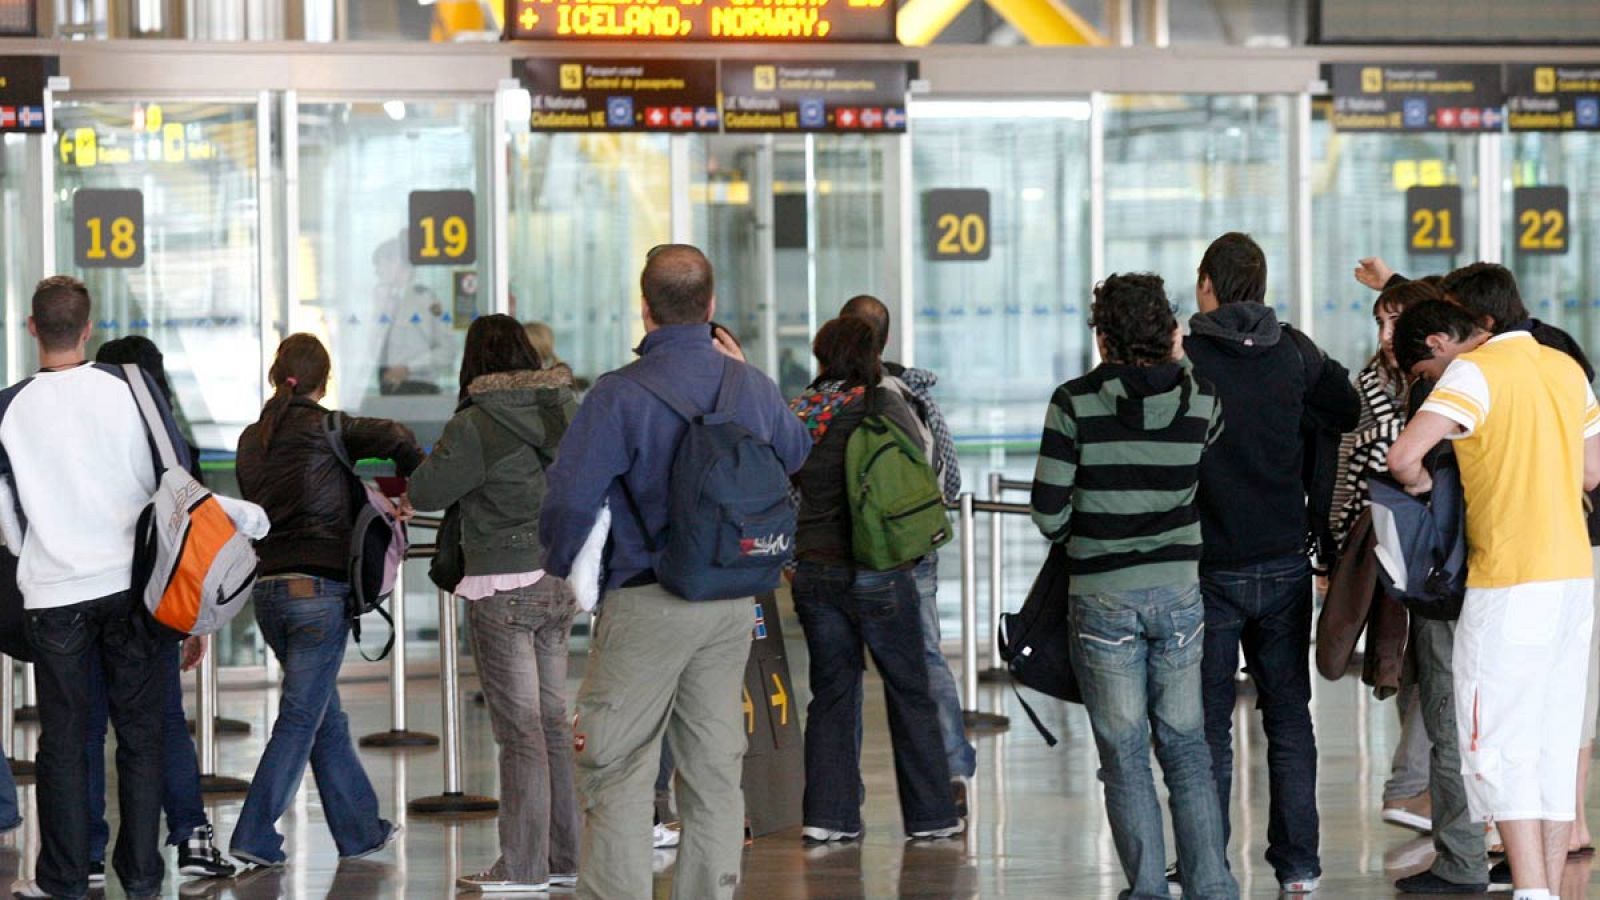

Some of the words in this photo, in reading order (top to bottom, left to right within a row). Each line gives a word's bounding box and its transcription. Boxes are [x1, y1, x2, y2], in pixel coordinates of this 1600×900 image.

[556, 5, 692, 36] ICELAND,
[711, 6, 831, 37] NORWAY,
[586, 76, 619, 89] Control
[621, 77, 633, 89] de
[86, 216, 136, 260] 18
[420, 215, 468, 257] 19
[937, 213, 985, 254] 20
[1412, 208, 1455, 249] 21
[1519, 208, 1565, 249] 22
